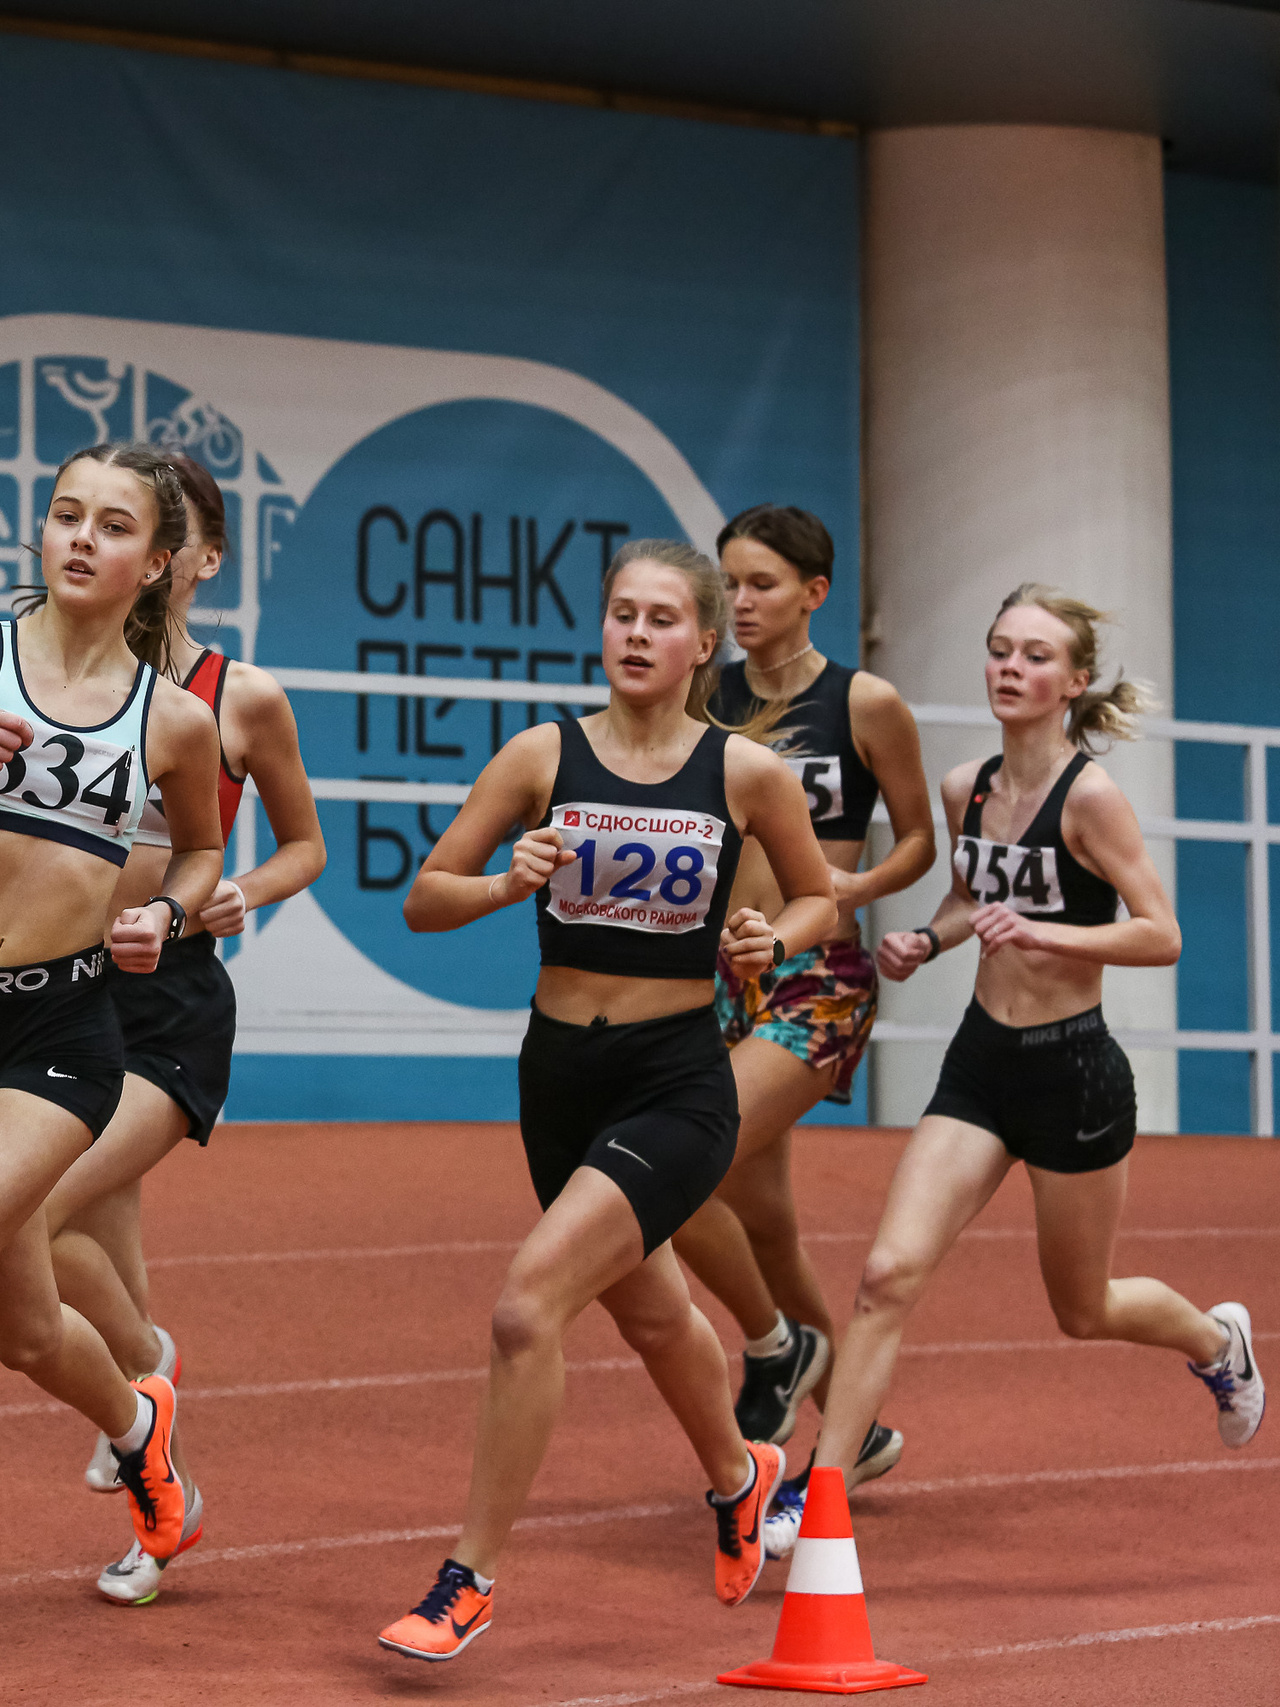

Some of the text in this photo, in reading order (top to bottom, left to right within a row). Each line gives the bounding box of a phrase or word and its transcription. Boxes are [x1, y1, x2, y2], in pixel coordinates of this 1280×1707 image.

[802, 762, 834, 820] 5
[586, 813, 714, 839] СДЮСШОР-2
[574, 838, 705, 906] 128
[963, 839, 1051, 905] 254
[558, 898, 698, 925] МОСКОВСКОГО РАЙОНА
[1021, 1012, 1098, 1046] NIKE PRO
